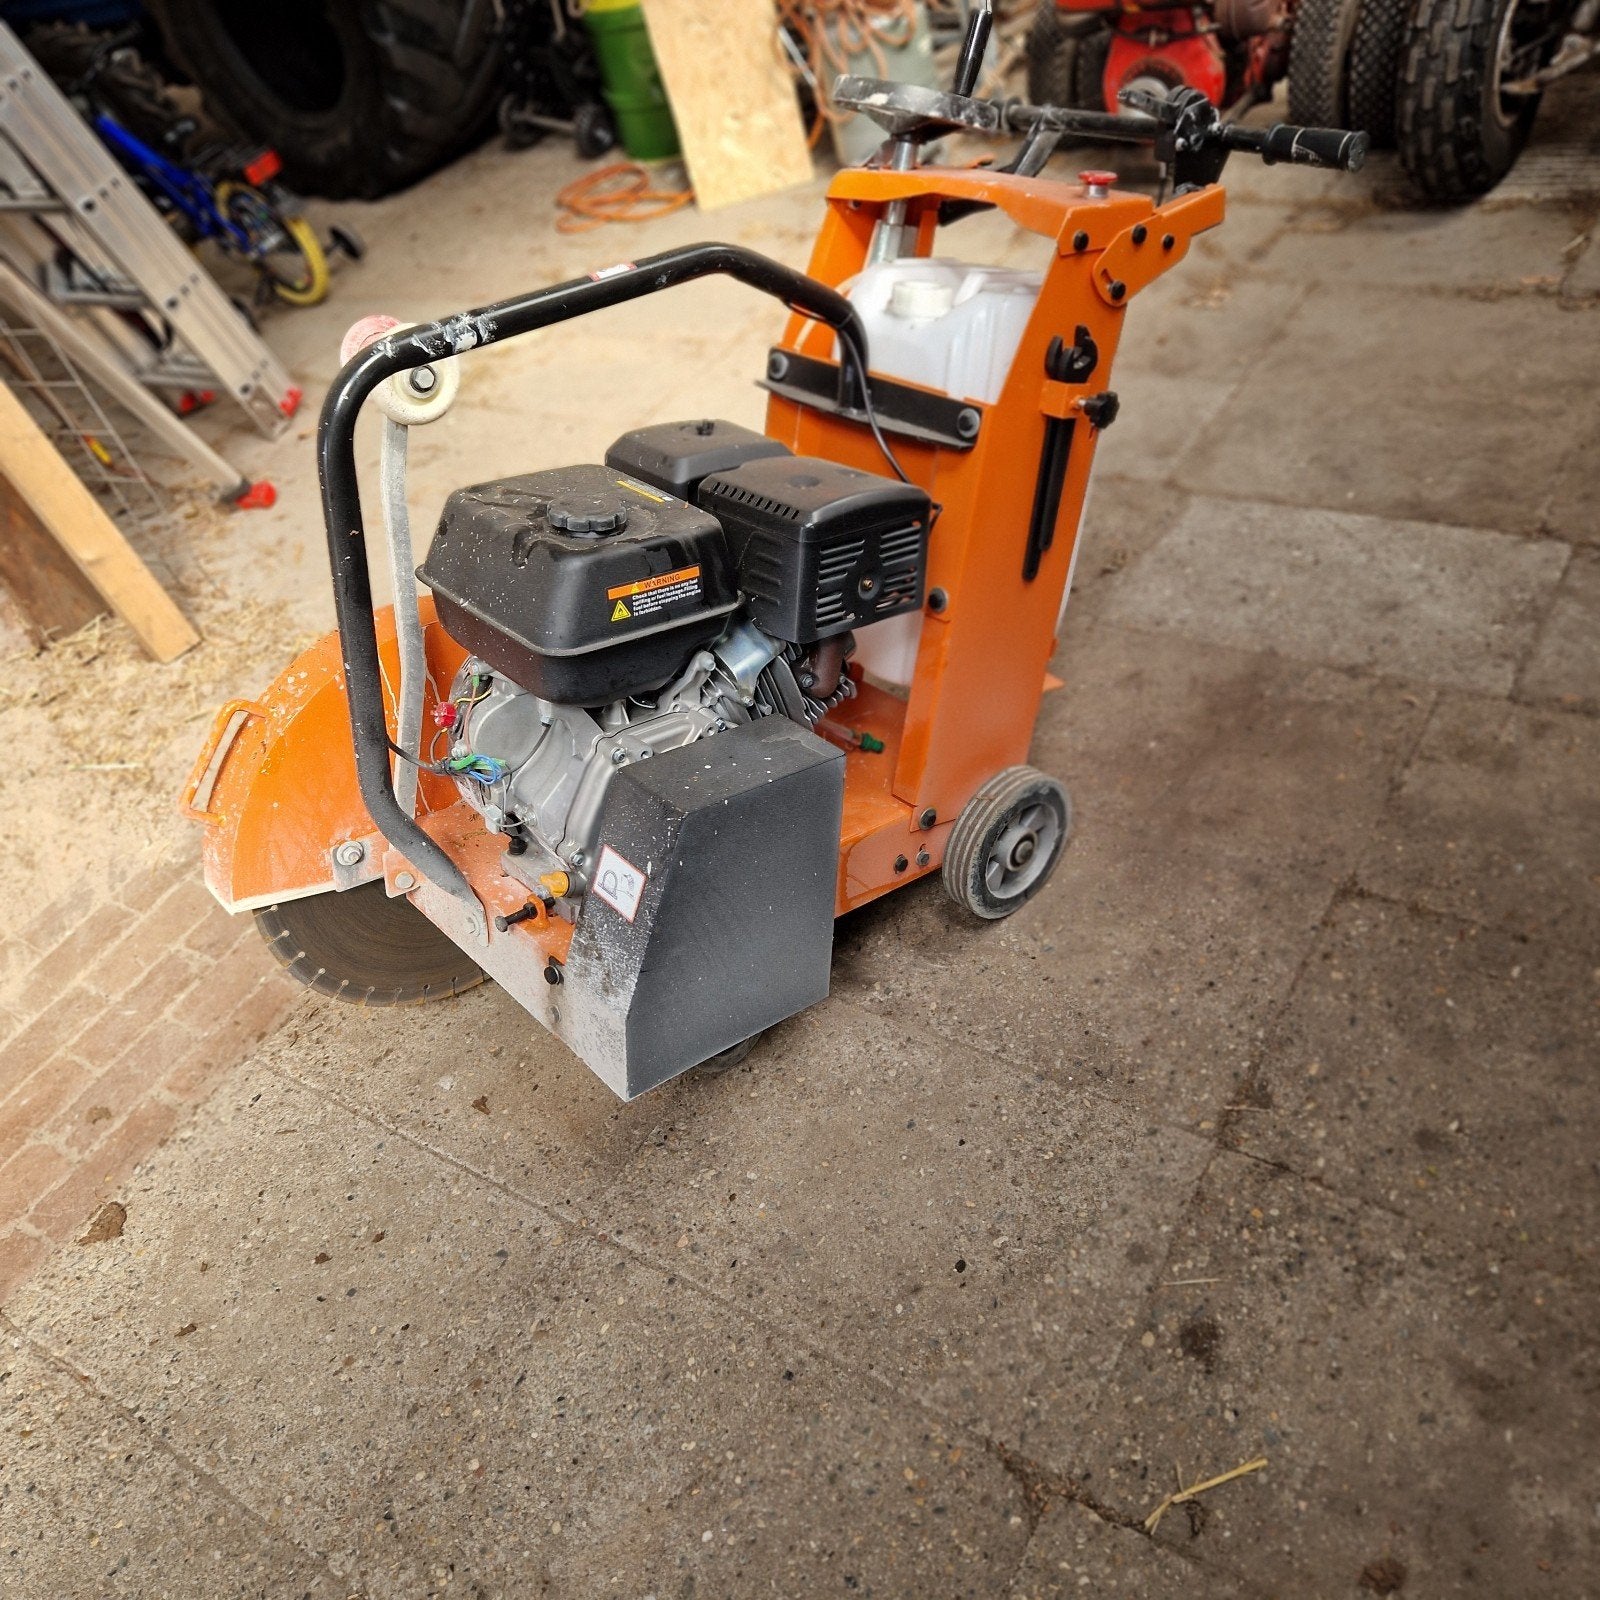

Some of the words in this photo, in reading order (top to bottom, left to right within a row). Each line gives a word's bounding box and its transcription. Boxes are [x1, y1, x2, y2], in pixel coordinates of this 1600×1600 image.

[644, 574, 680, 589] WARNING
[643, 600, 658, 608] before
[659, 595, 678, 604] stopping
